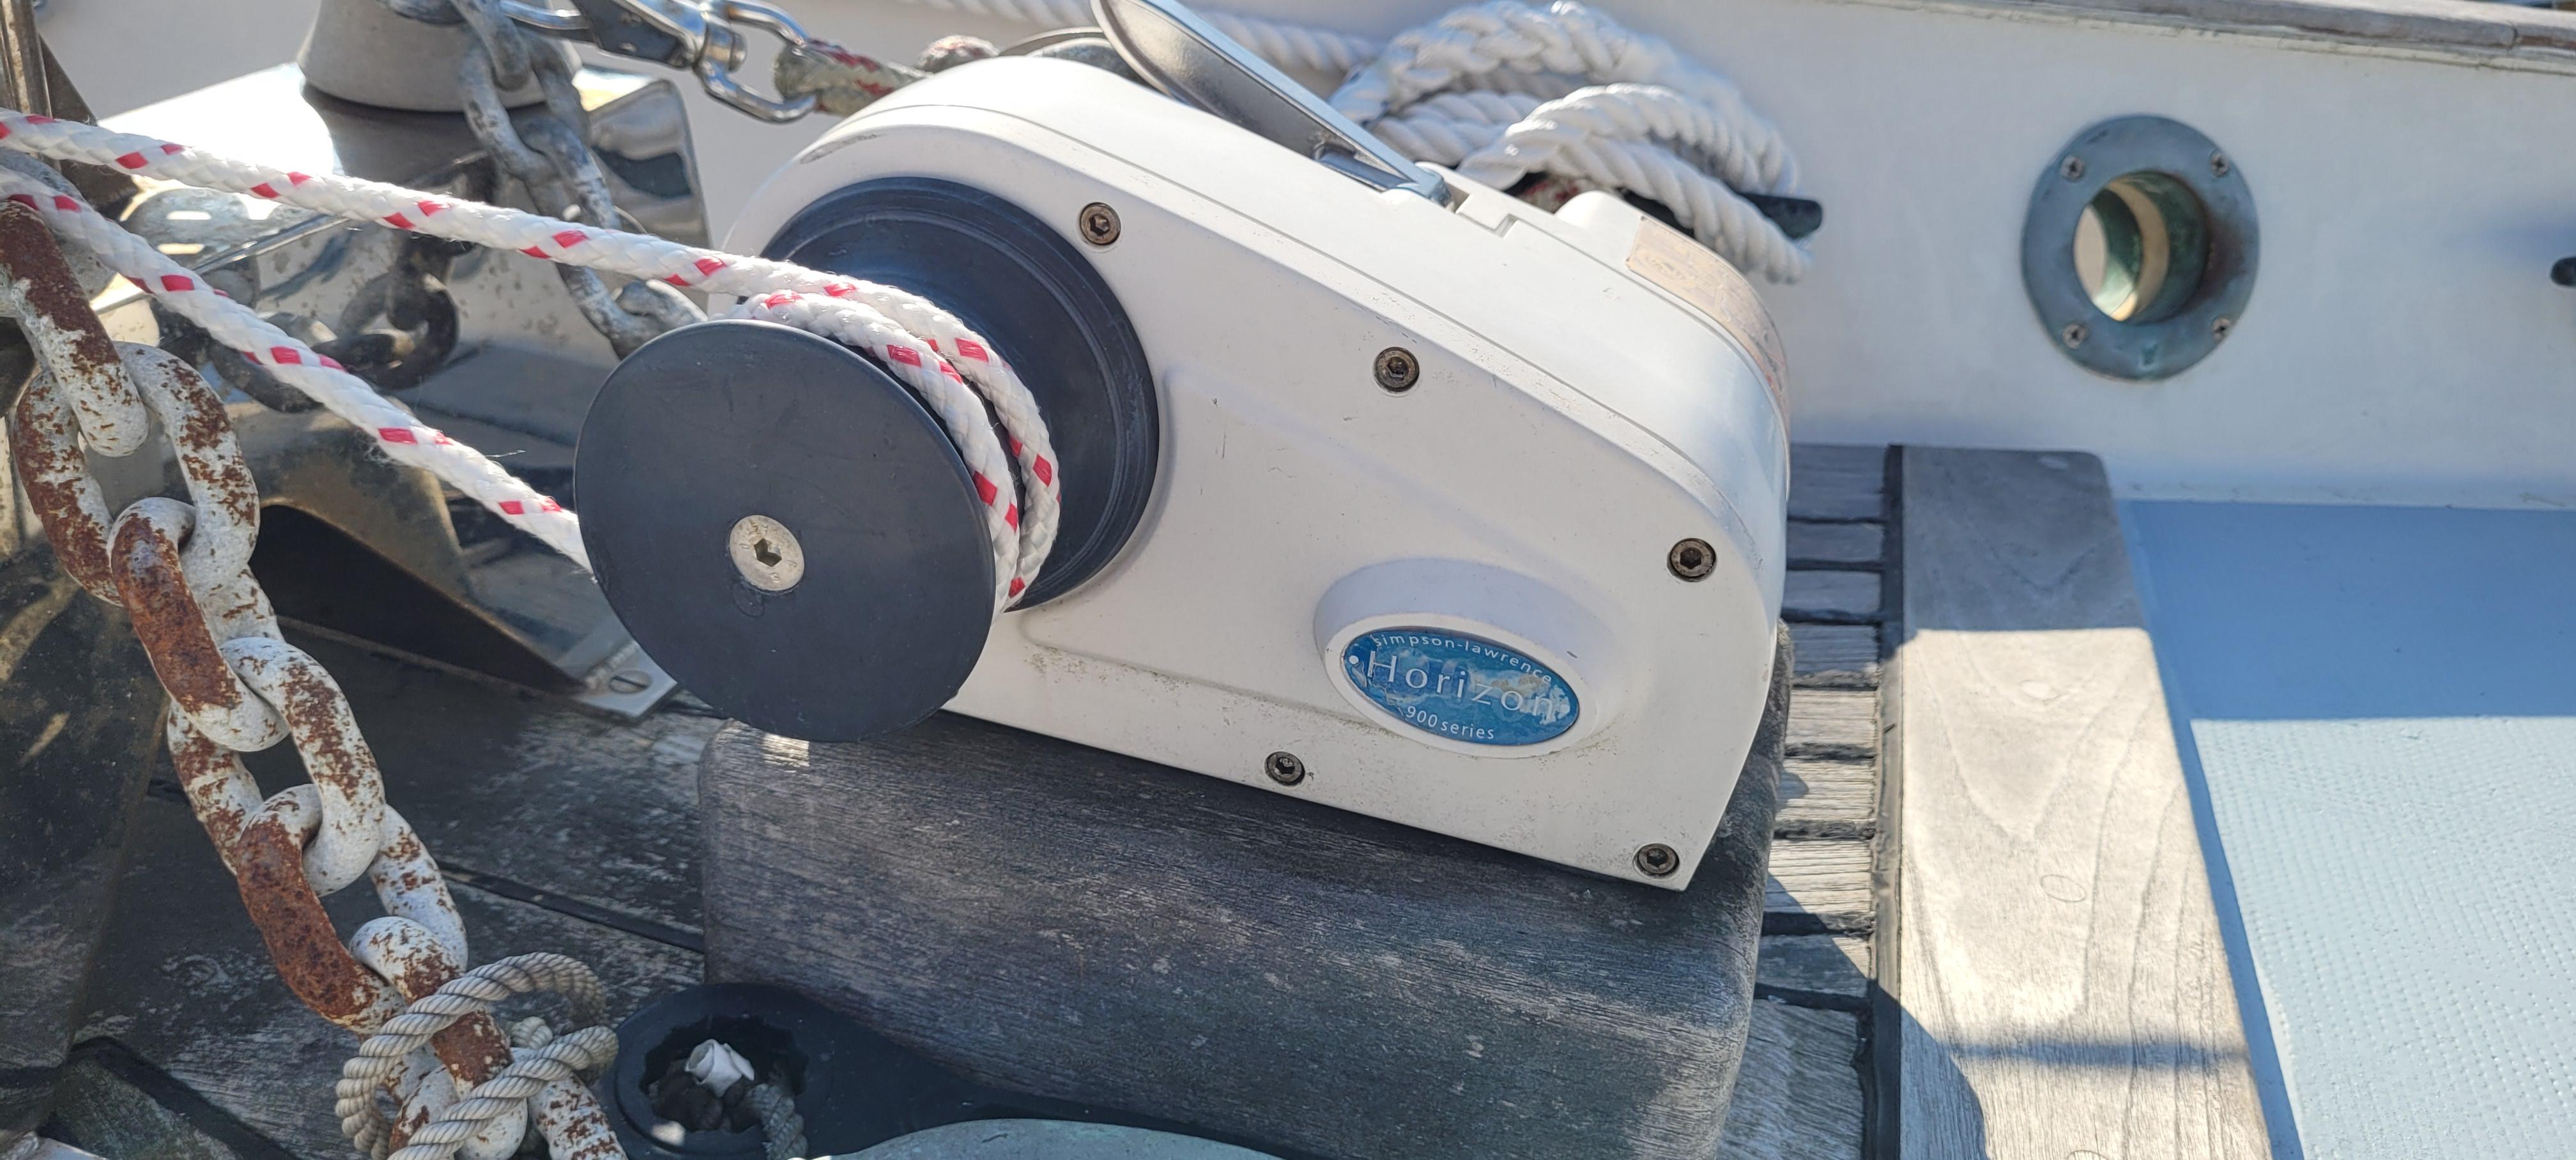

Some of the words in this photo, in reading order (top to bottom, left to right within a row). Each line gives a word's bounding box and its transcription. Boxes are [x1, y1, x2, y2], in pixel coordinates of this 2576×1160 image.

[1374, 634, 1552, 684] simpson-lawrence
[1367, 650, 1555, 722] Horizon
[1406, 705, 1438, 728] 900
[1440, 721, 1494, 740] series
